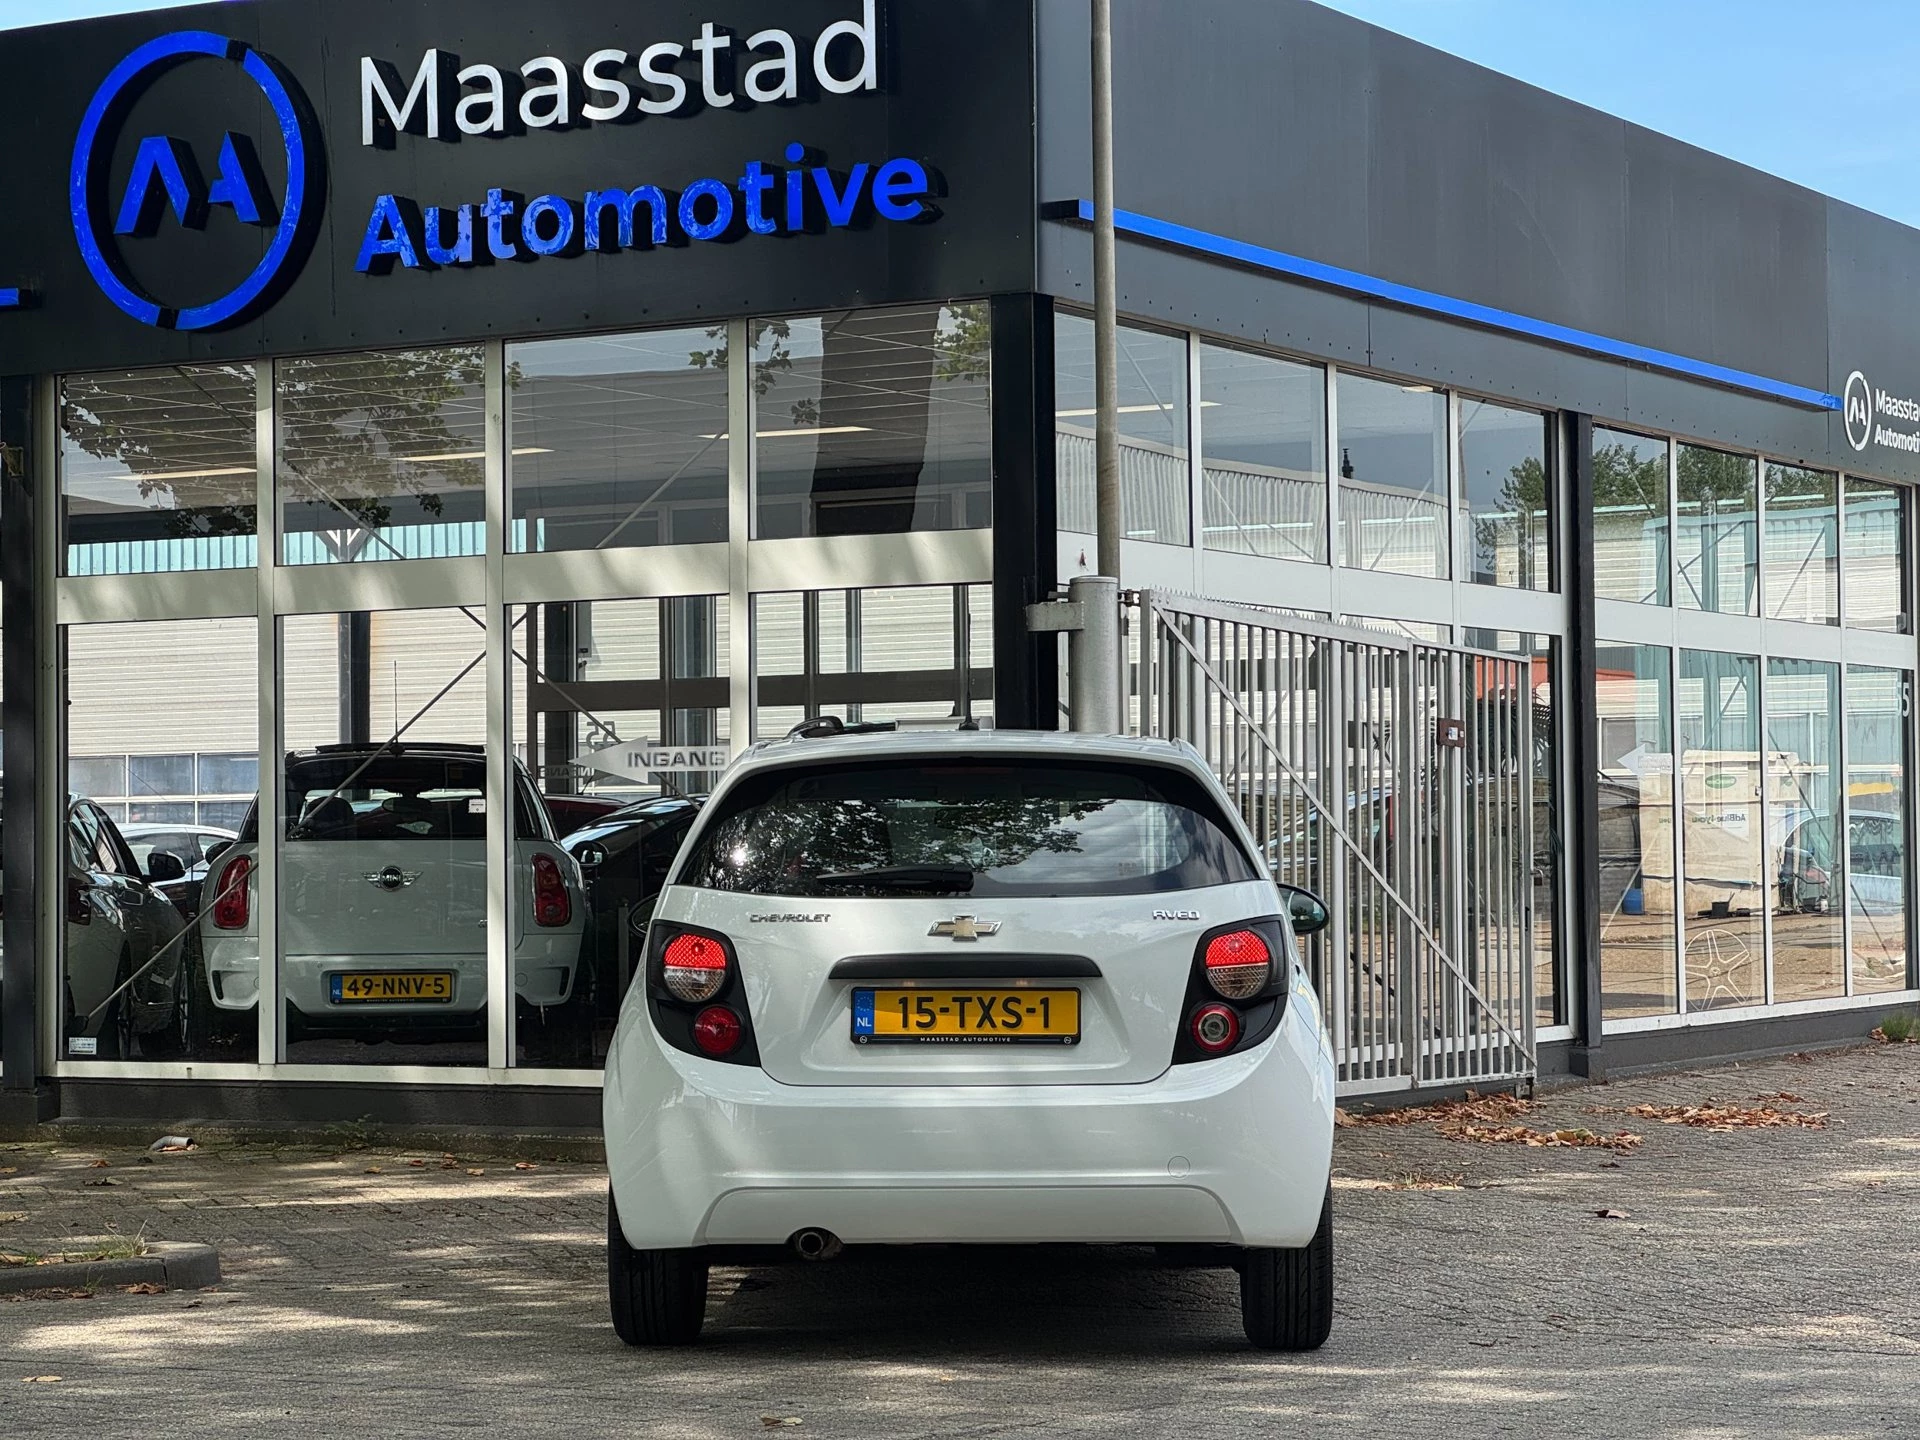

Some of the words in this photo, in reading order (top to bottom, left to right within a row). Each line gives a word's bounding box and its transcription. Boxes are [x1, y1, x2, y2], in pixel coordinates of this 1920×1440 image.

[361, 0, 878, 145] Maasstad
[355, 142, 928, 271] Automotive
[1875, 388, 1920, 422] Maassta
[1874, 423, 1920, 453] Automoti
[627, 751, 725, 768] INGANG
[749, 913, 831, 923] CHEVROLET
[1152, 909, 1200, 920] AVEO
[347, 977, 445, 996] 49-NNV-5
[856, 1017, 872, 1028] NL
[898, 996, 1050, 1029] 15-TXS-1
